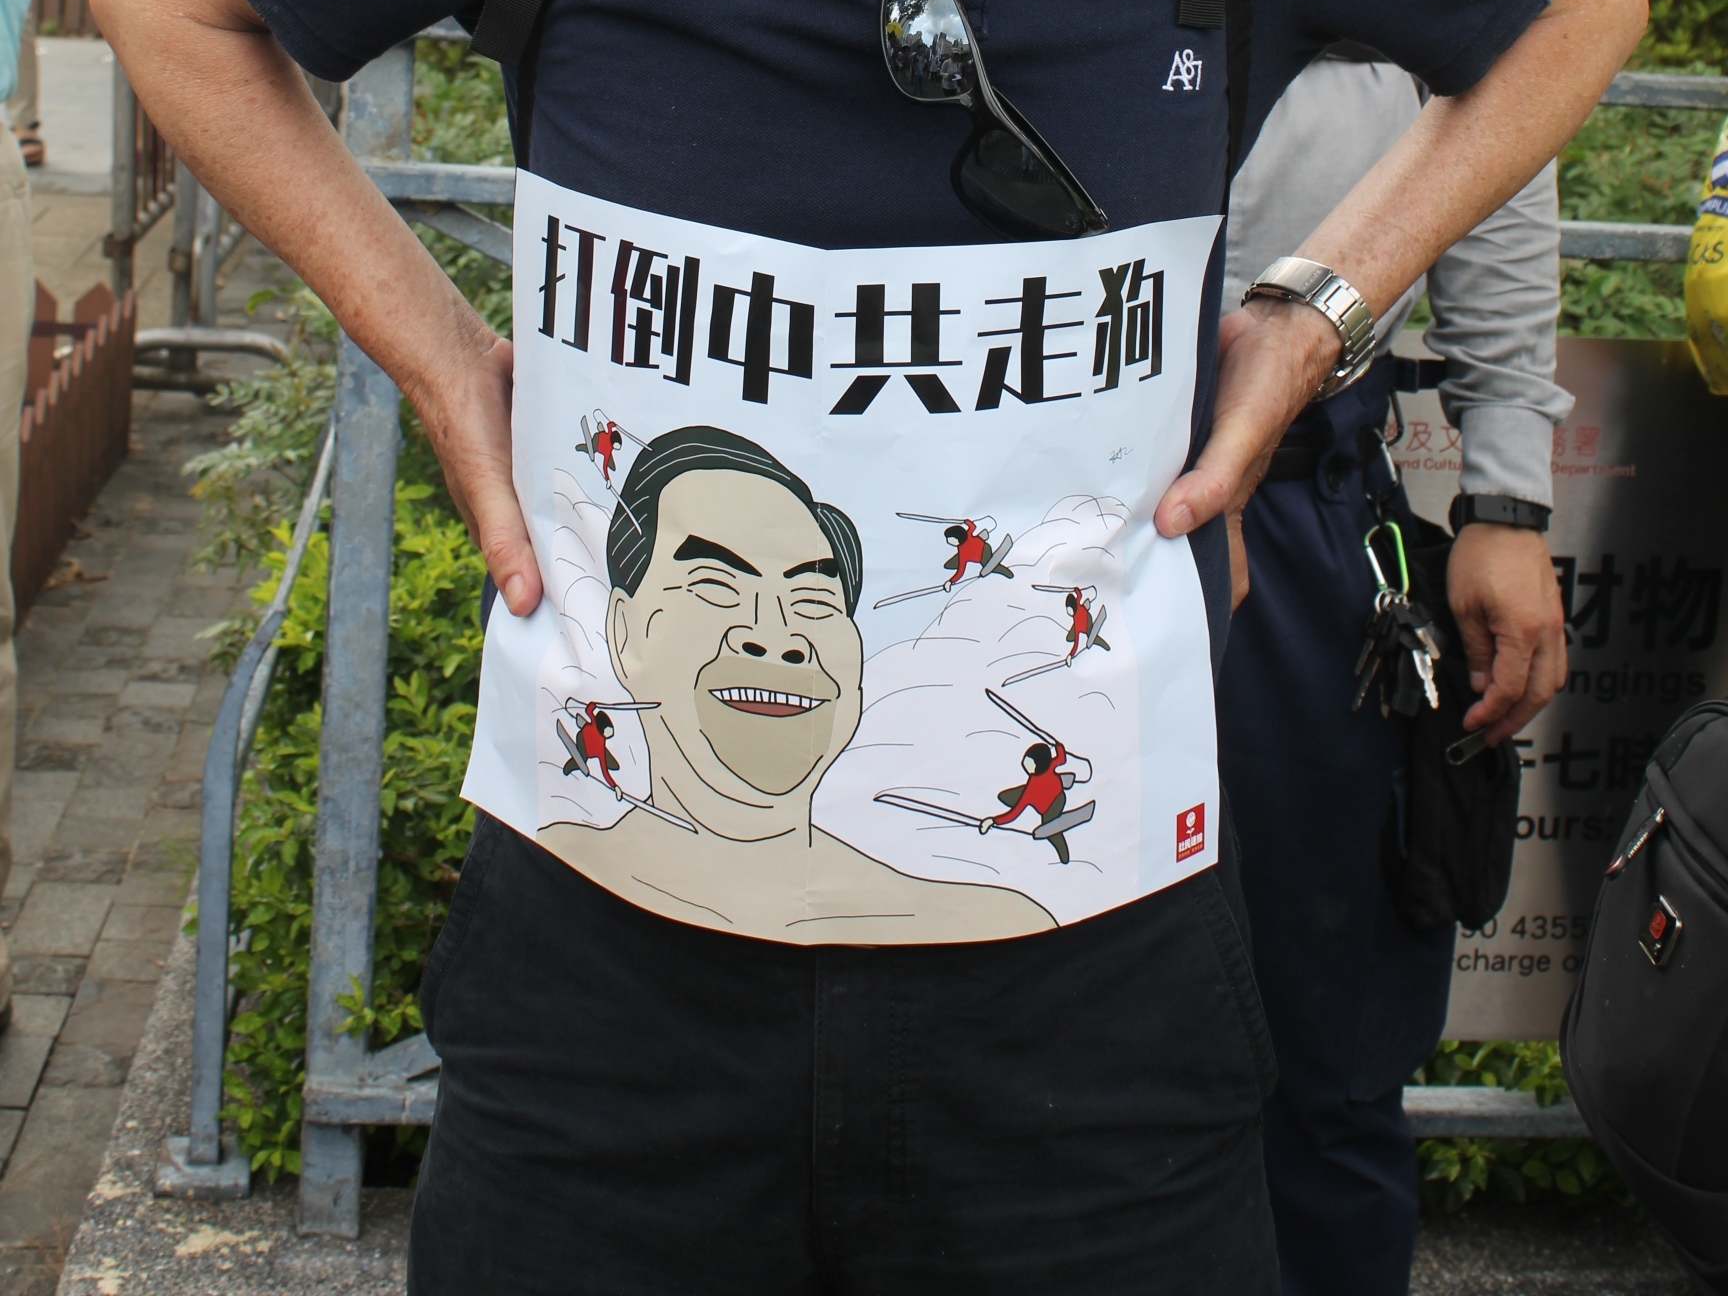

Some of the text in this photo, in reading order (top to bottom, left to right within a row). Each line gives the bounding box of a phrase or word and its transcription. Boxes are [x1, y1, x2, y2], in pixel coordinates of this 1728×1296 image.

[538, 215, 1164, 415] 打倒中共走狗
[1511, 915, 1588, 940] 4355
